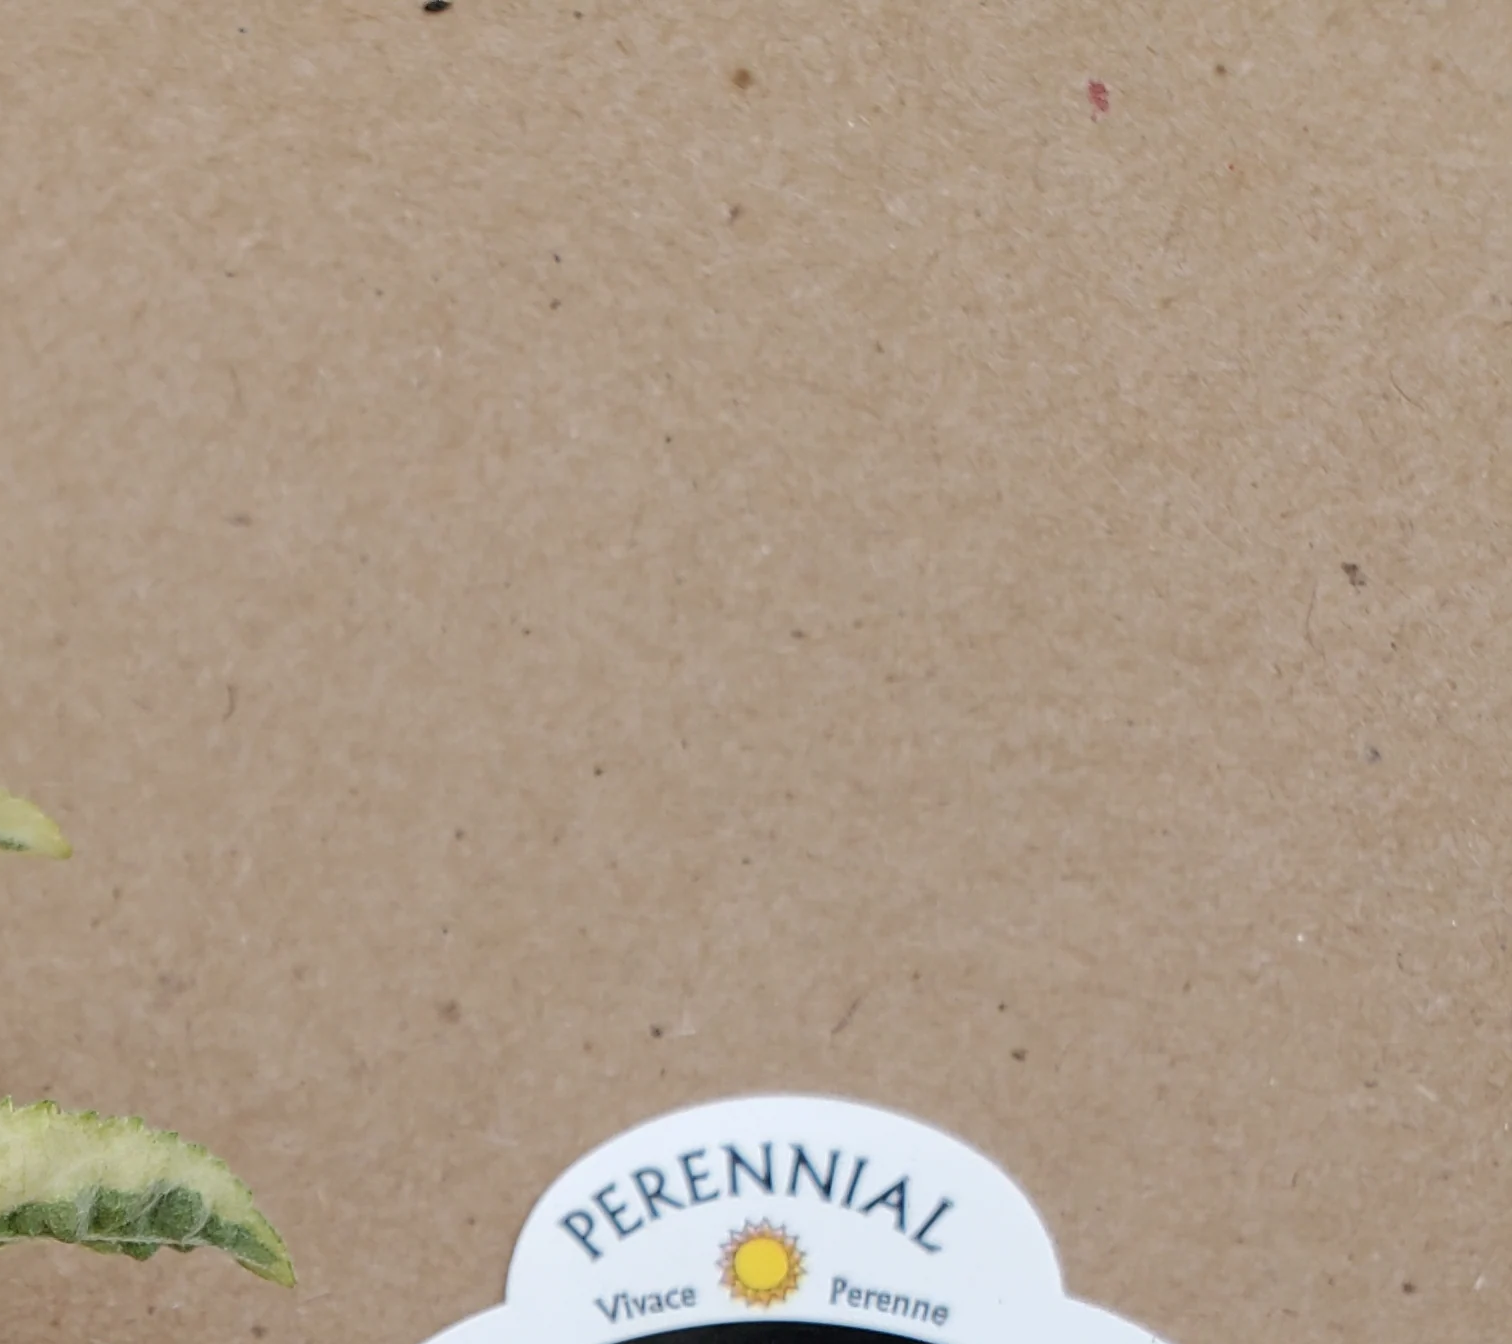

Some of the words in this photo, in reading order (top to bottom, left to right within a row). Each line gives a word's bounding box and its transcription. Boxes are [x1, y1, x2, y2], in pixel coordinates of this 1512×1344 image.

[558, 1142, 956, 1261] PERENNIAL
[596, 1283, 698, 1324] Vivace
[830, 1278, 951, 1328] Perenne
